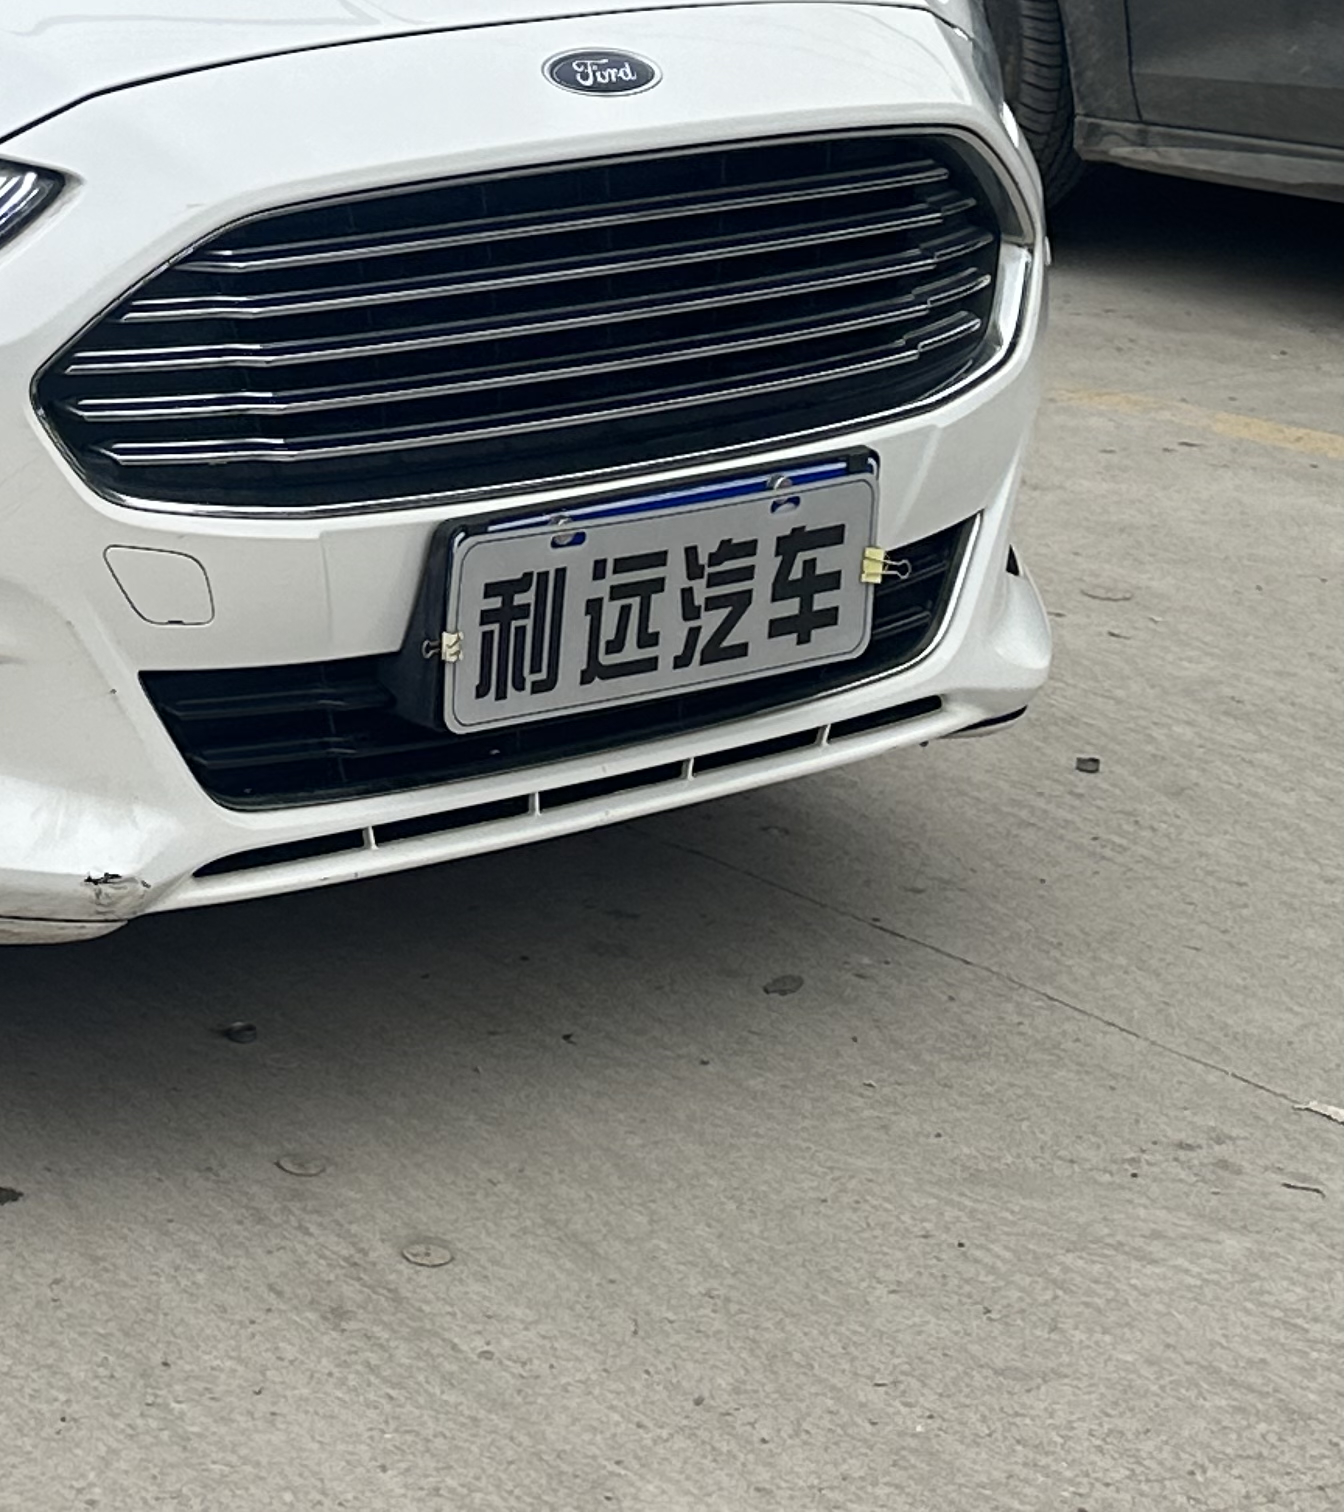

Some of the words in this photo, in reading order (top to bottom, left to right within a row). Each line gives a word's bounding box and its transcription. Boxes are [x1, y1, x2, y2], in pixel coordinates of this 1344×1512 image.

[572, 58, 637, 86] Ford
[475, 524, 845, 701] 利远汽车
